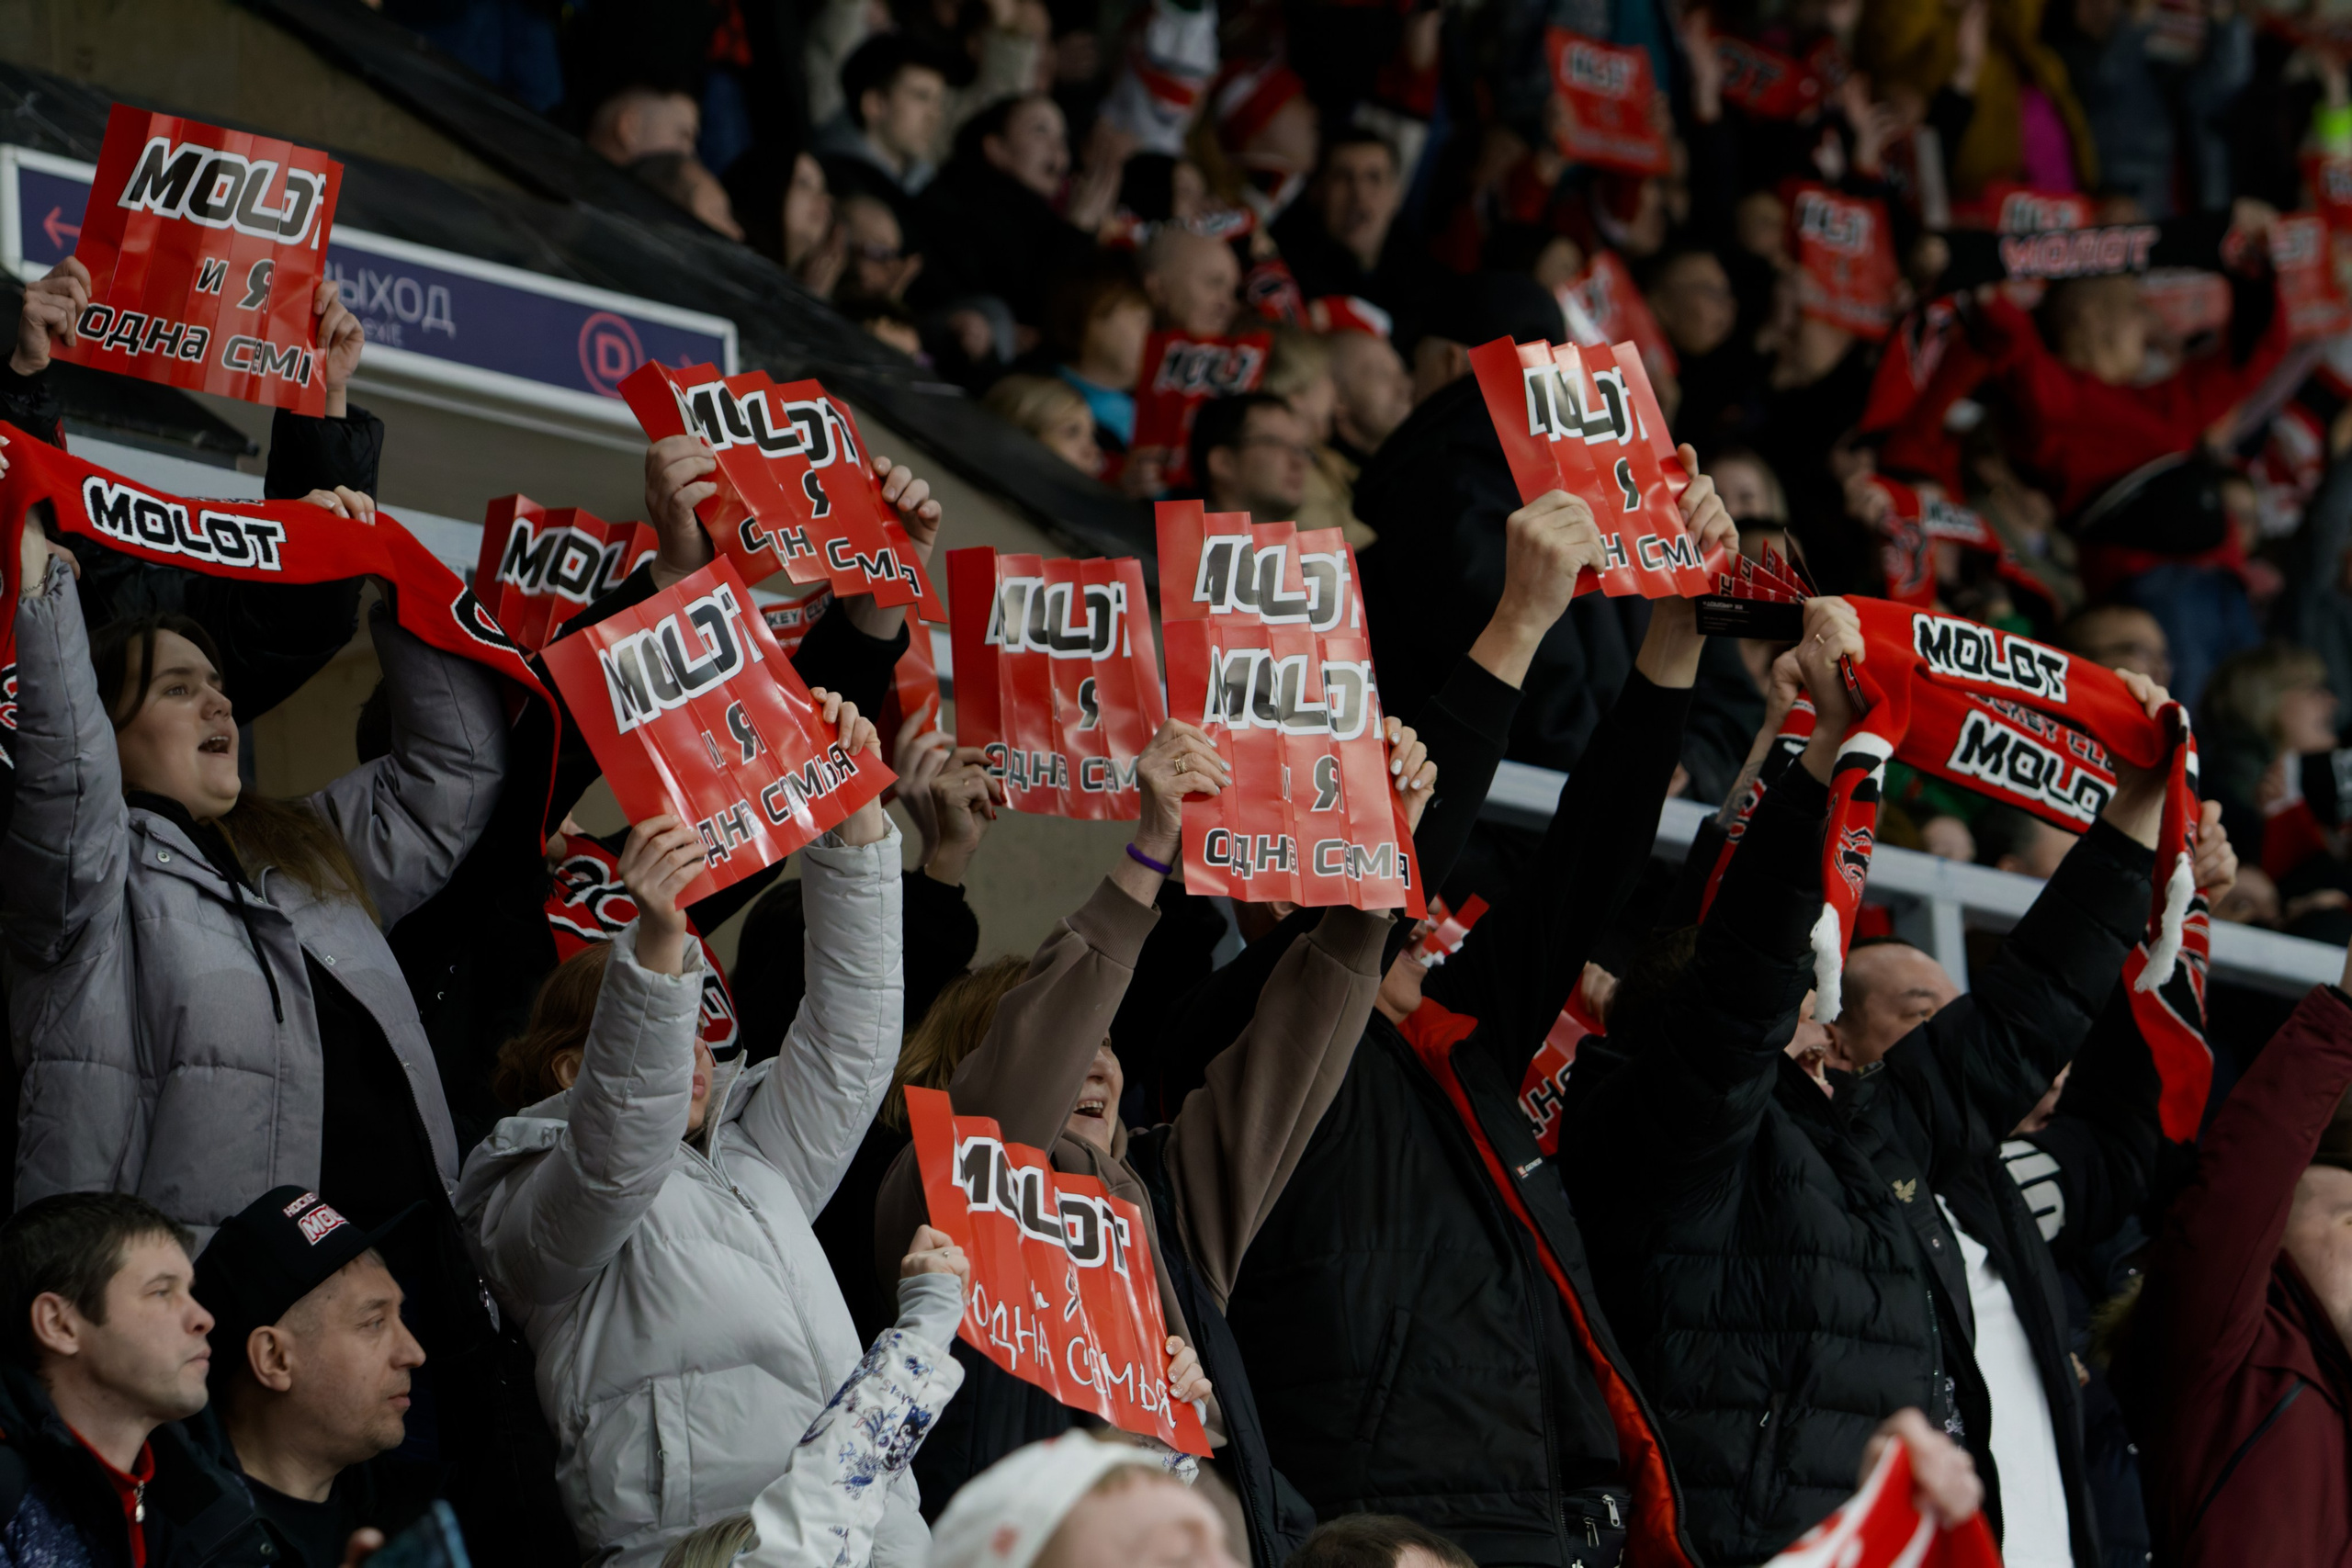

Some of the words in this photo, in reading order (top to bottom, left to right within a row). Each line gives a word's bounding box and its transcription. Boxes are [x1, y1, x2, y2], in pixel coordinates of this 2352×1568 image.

[1522, 364, 1649, 446] MOLO
[82, 476, 287, 571] MOLOT
[984, 576, 1132, 661] MOLO
[1193, 535, 1361, 632] MOLO
[1203, 645, 1385, 740] MOLO
[1913, 613, 2069, 704] MOLOT
[726, 699, 767, 765] Я
[1946, 709, 2118, 824] MOLO
[1310, 754, 1345, 814] Я
[696, 798, 764, 869] дна
